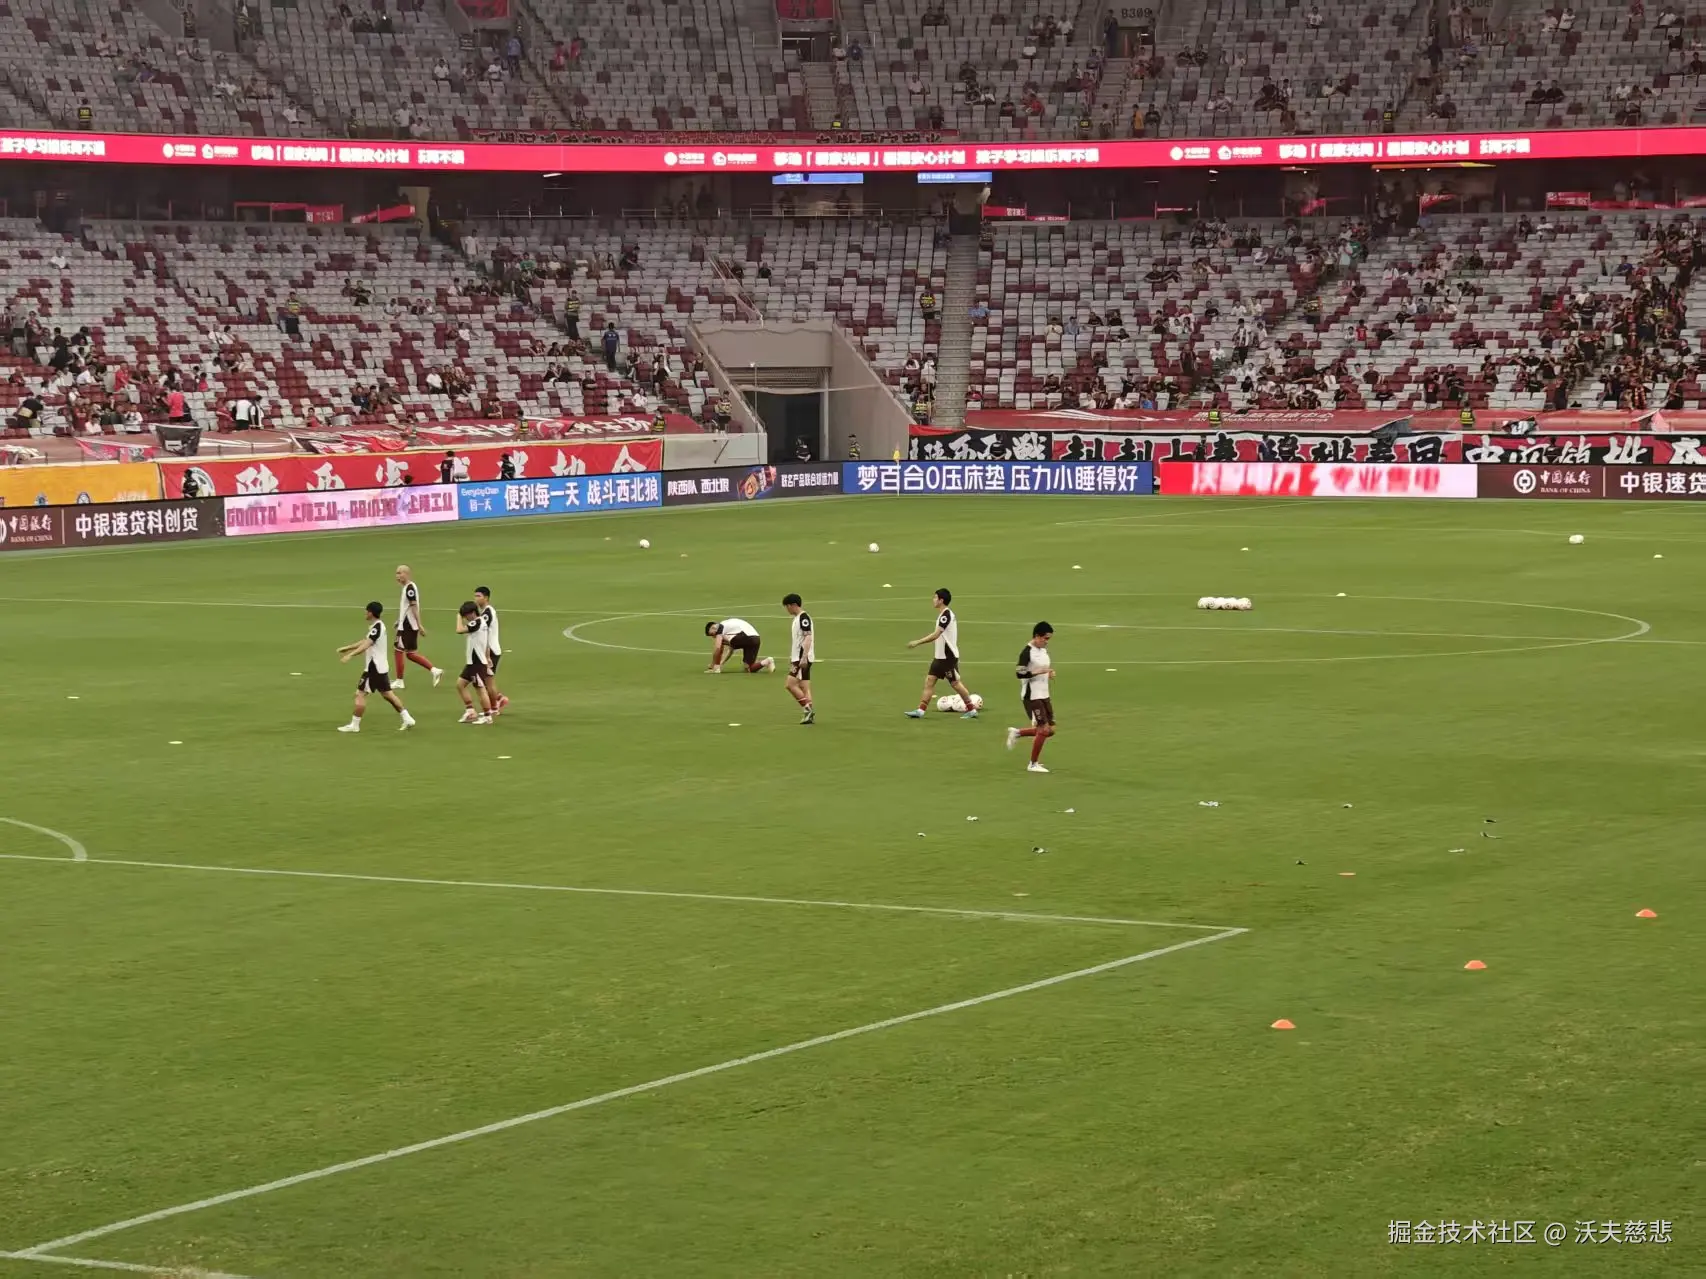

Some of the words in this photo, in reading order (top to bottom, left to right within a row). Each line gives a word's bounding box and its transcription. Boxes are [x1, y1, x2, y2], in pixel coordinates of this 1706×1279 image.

[667, 480, 699, 496] 陕西队
[701, 478, 730, 494] 西北狼
[857, 465, 1005, 491] 梦百合0压床垫
[1011, 465, 1138, 491] 压力小睡得好
[1540, 470, 1591, 485] 中国银行
[504, 482, 580, 511] 便利每一天
[587, 476, 659, 505] 战斗西北狼
[9, 514, 52, 533] 中国银行
[75, 507, 199, 539] 中银速贷科创贷
